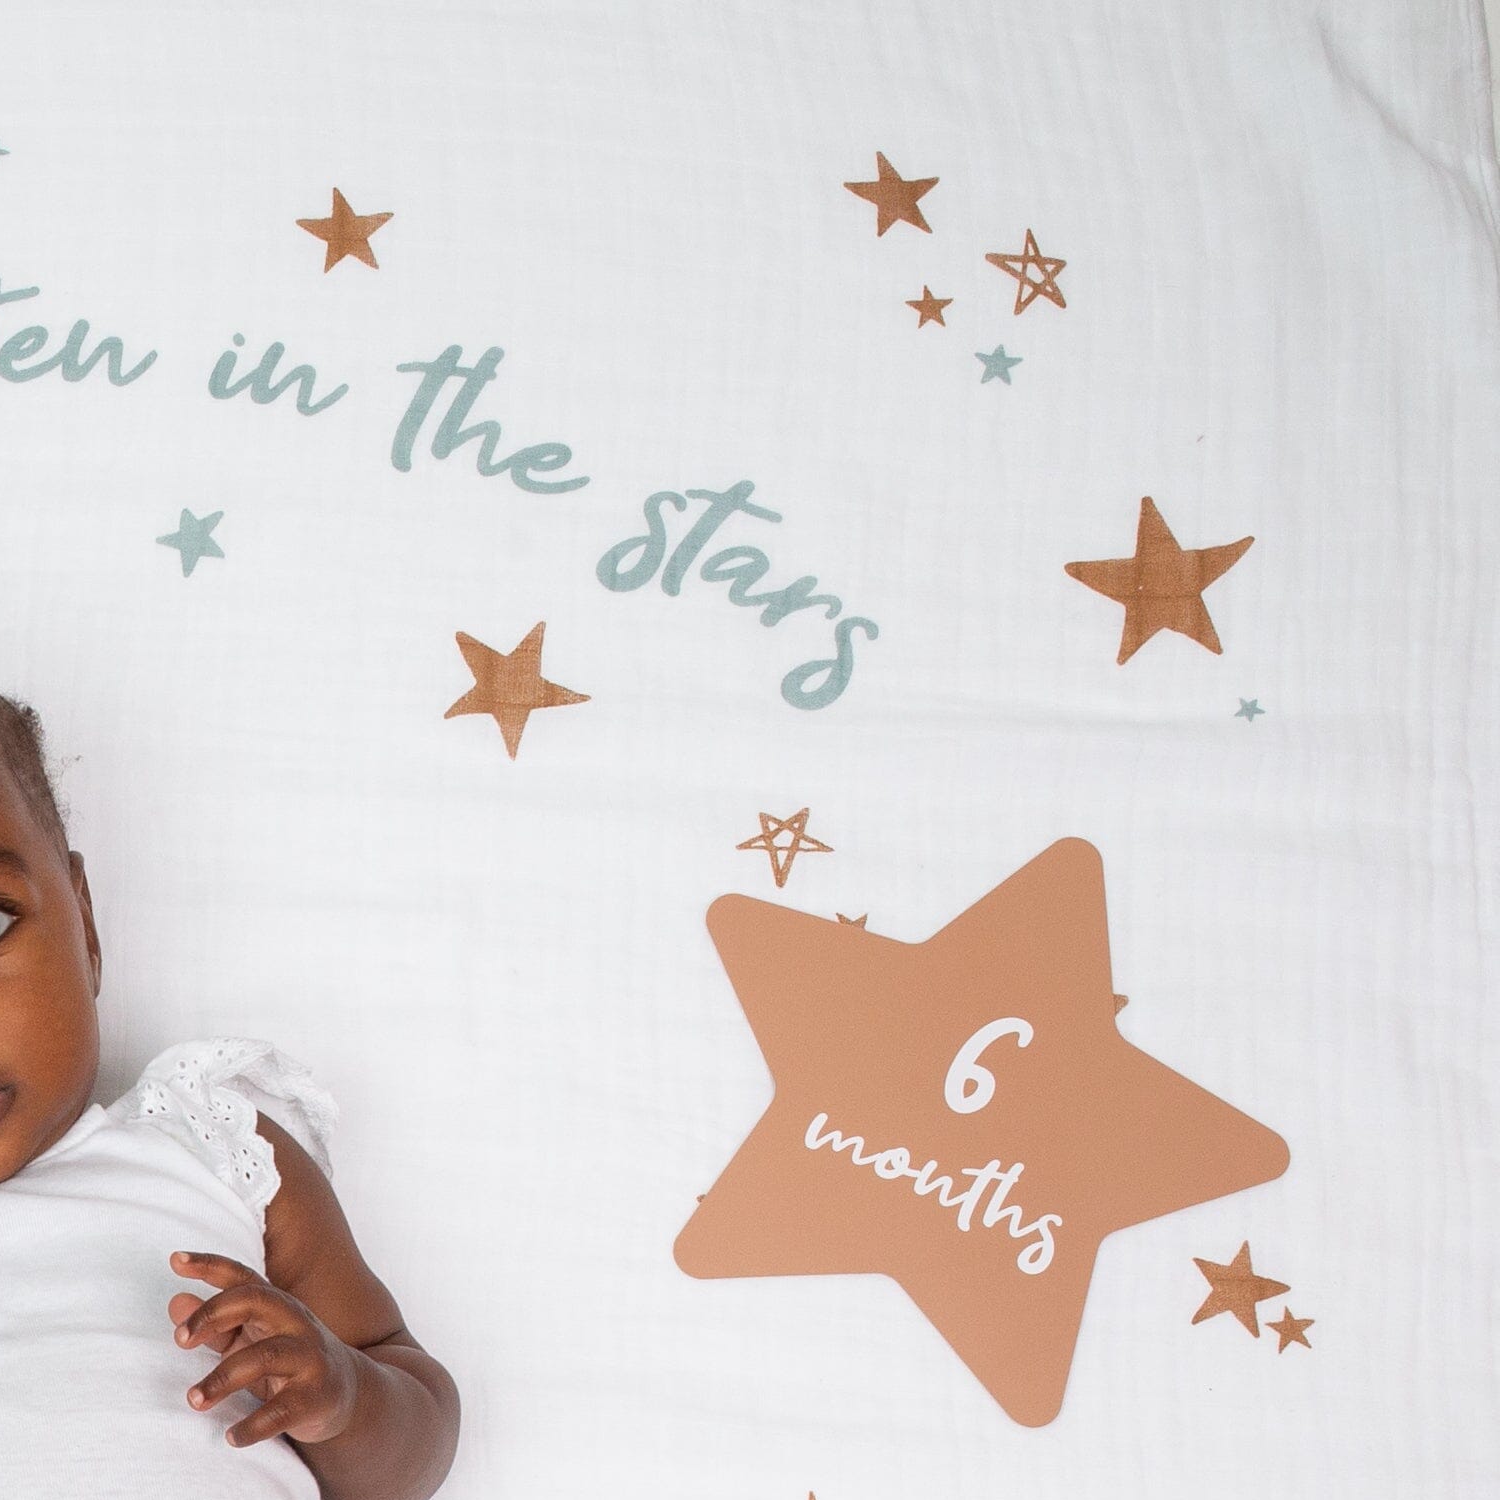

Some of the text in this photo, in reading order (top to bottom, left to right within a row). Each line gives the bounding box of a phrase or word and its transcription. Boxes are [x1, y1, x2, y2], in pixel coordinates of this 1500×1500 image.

[208, 333, 349, 416] in
[391, 344, 590, 494] the
[596, 480, 879, 711] stars
[944, 1017, 1034, 1115] 6
[804, 1112, 1063, 1276] months
